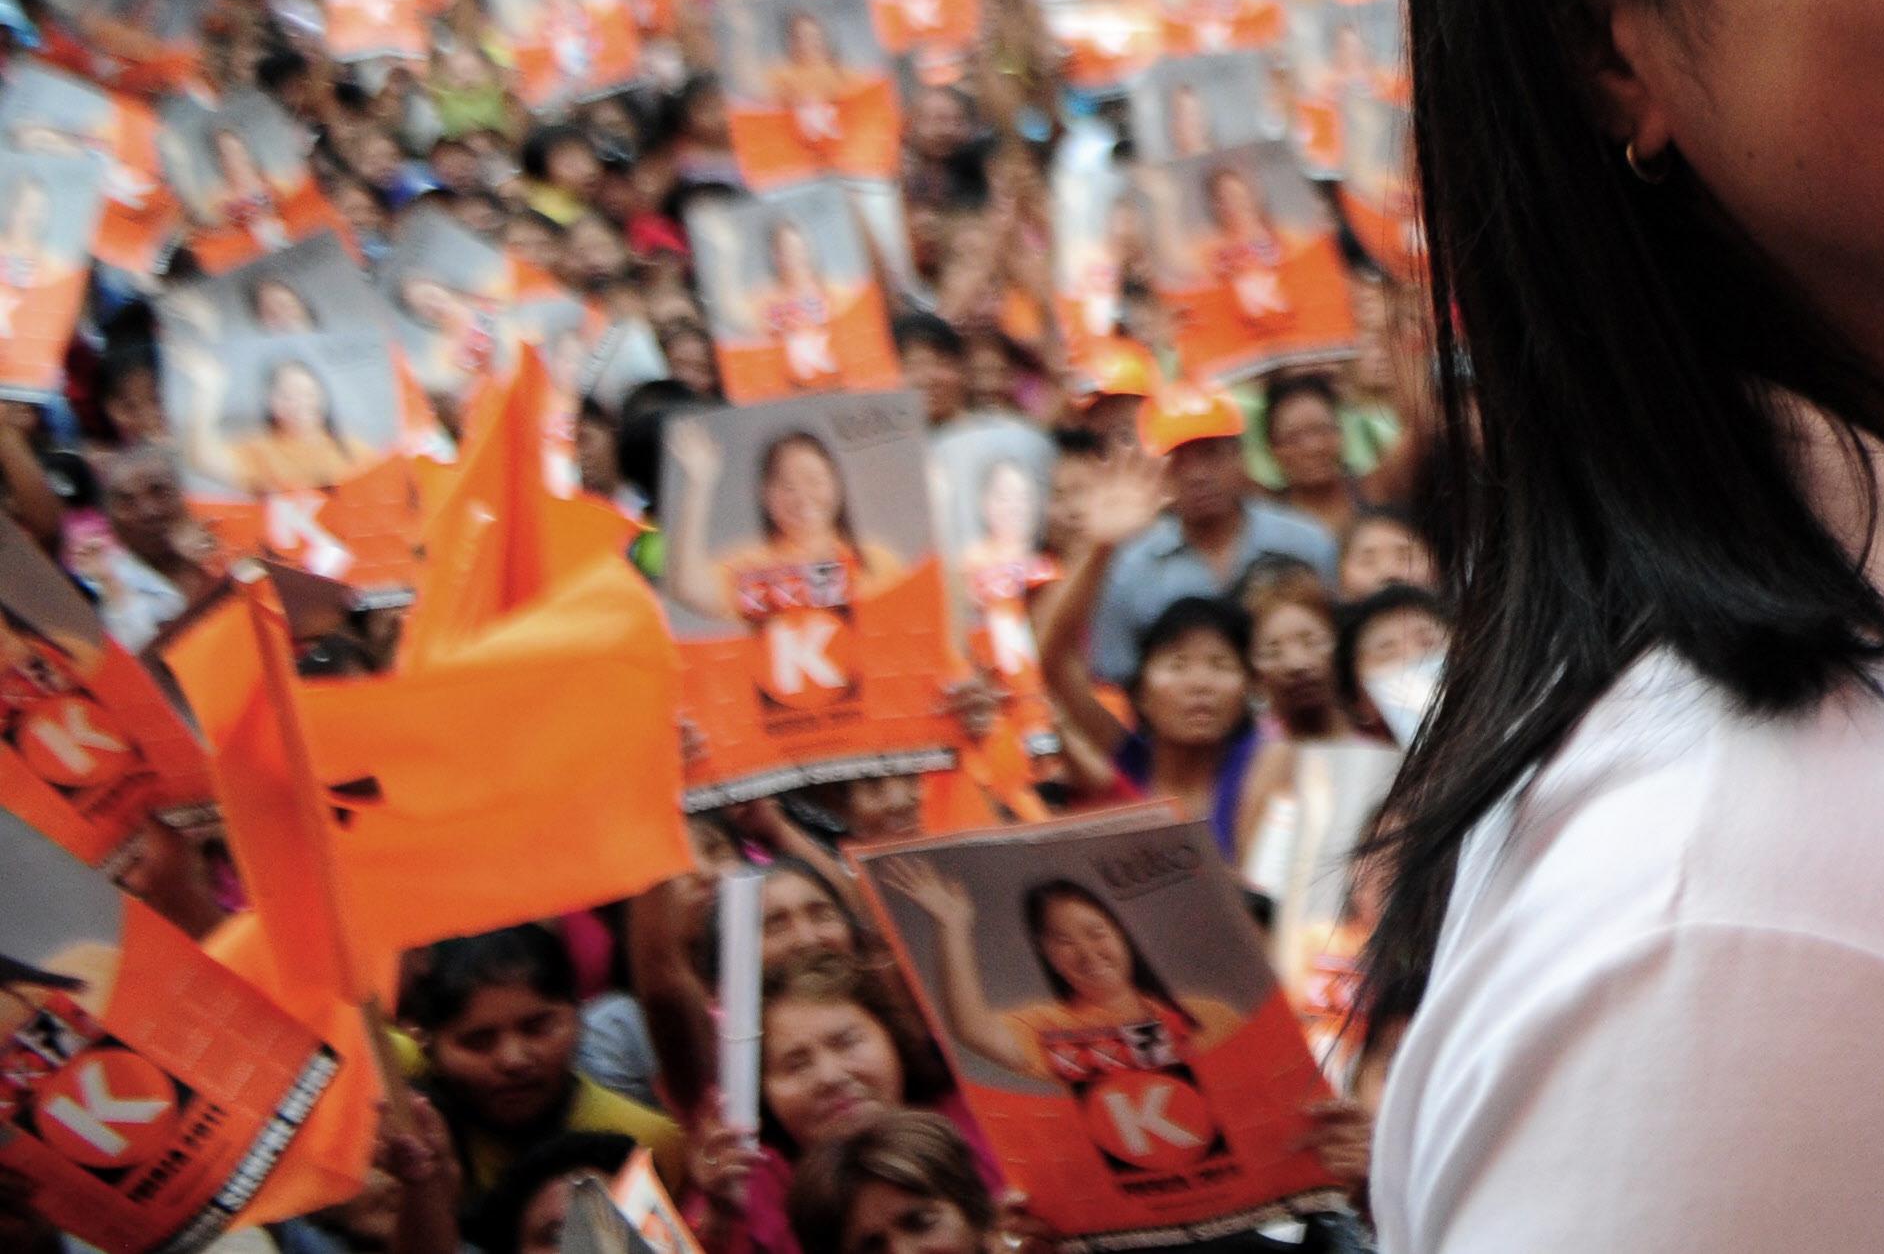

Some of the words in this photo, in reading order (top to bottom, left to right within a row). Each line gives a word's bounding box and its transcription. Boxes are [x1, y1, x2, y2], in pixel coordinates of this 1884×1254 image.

[768, 614, 850, 696] K
[28, 701, 133, 777] K
[44, 1058, 172, 1159] K
[1103, 1083, 1206, 1157] K
